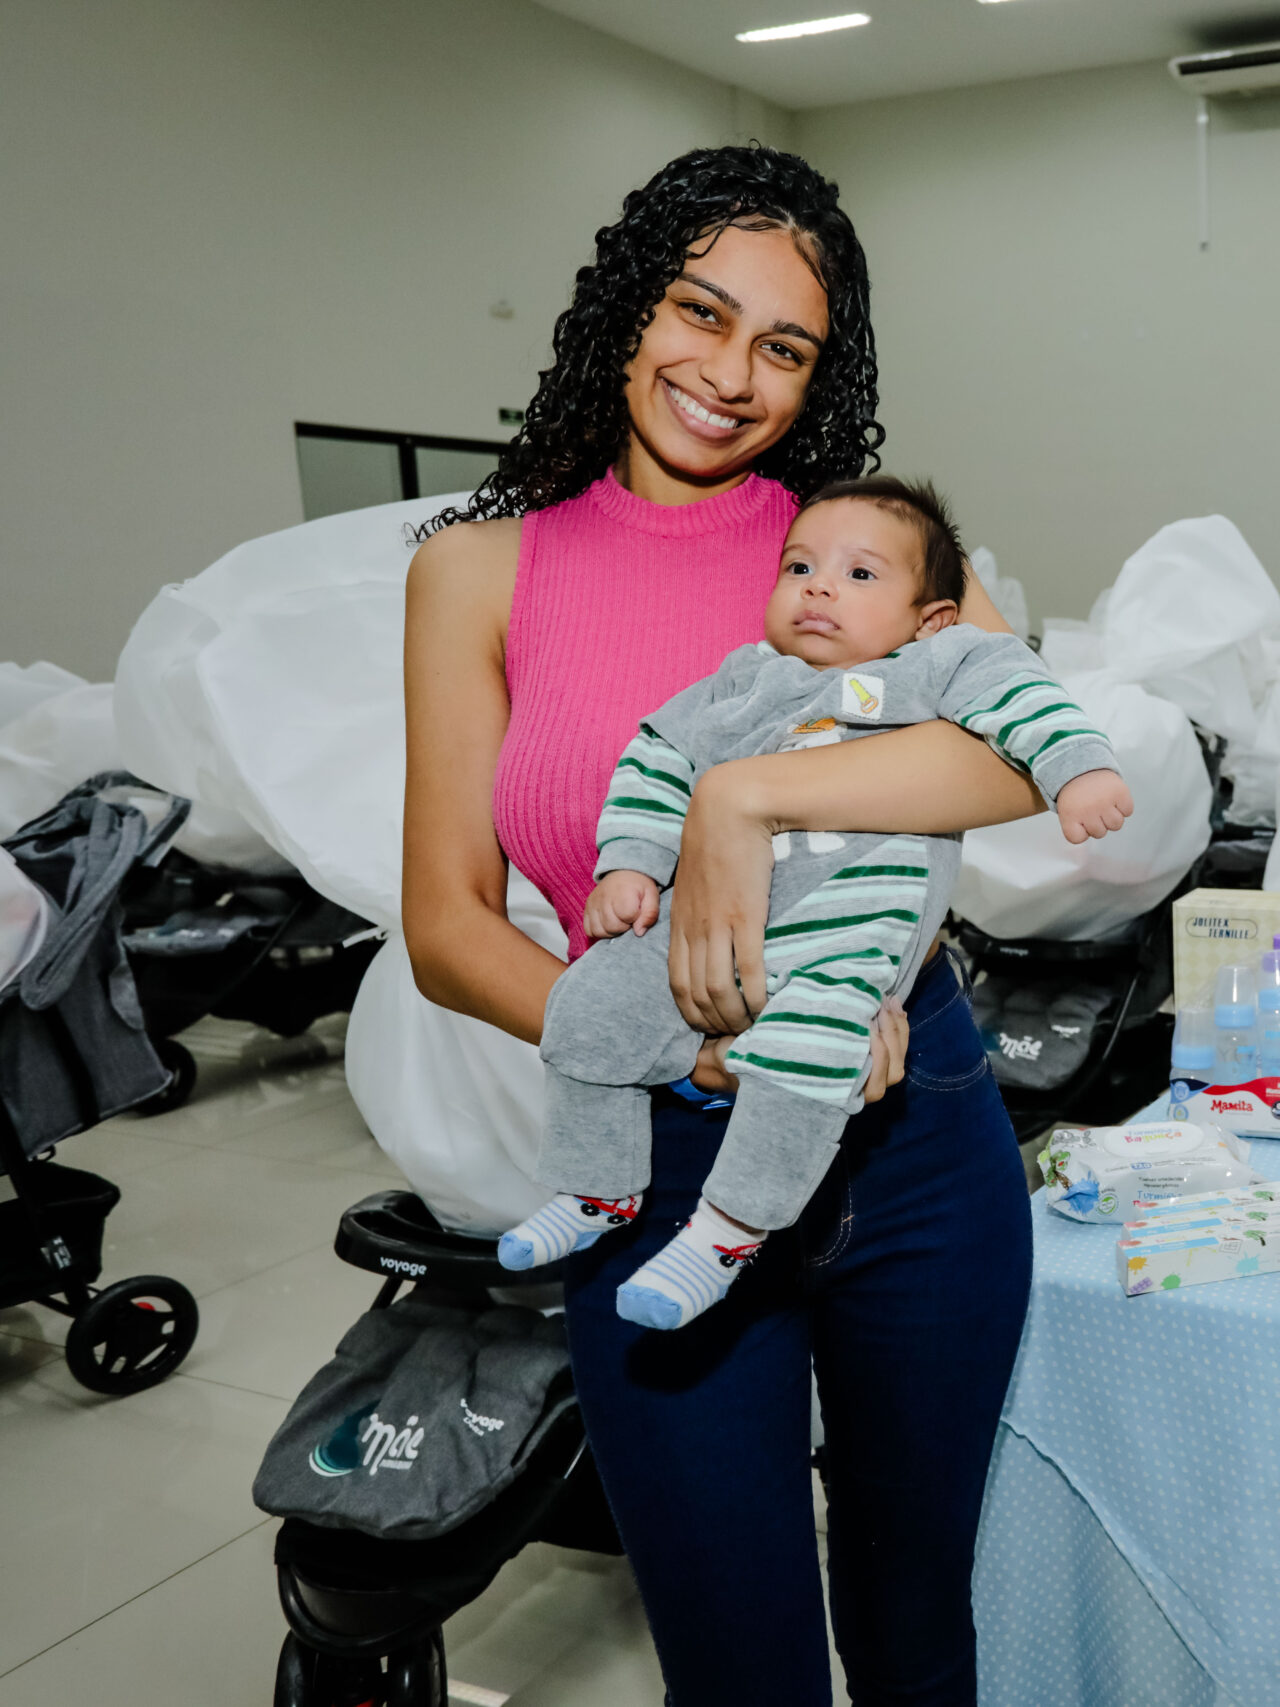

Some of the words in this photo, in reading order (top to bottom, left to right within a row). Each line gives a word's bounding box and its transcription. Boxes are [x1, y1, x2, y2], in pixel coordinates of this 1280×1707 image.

[1192, 917, 1229, 927] JOLITEX
[1208, 928, 1249, 939] TERNILLE
[1210, 1099, 1253, 1114] Mamita
[380, 1256, 427, 1276] voyage
